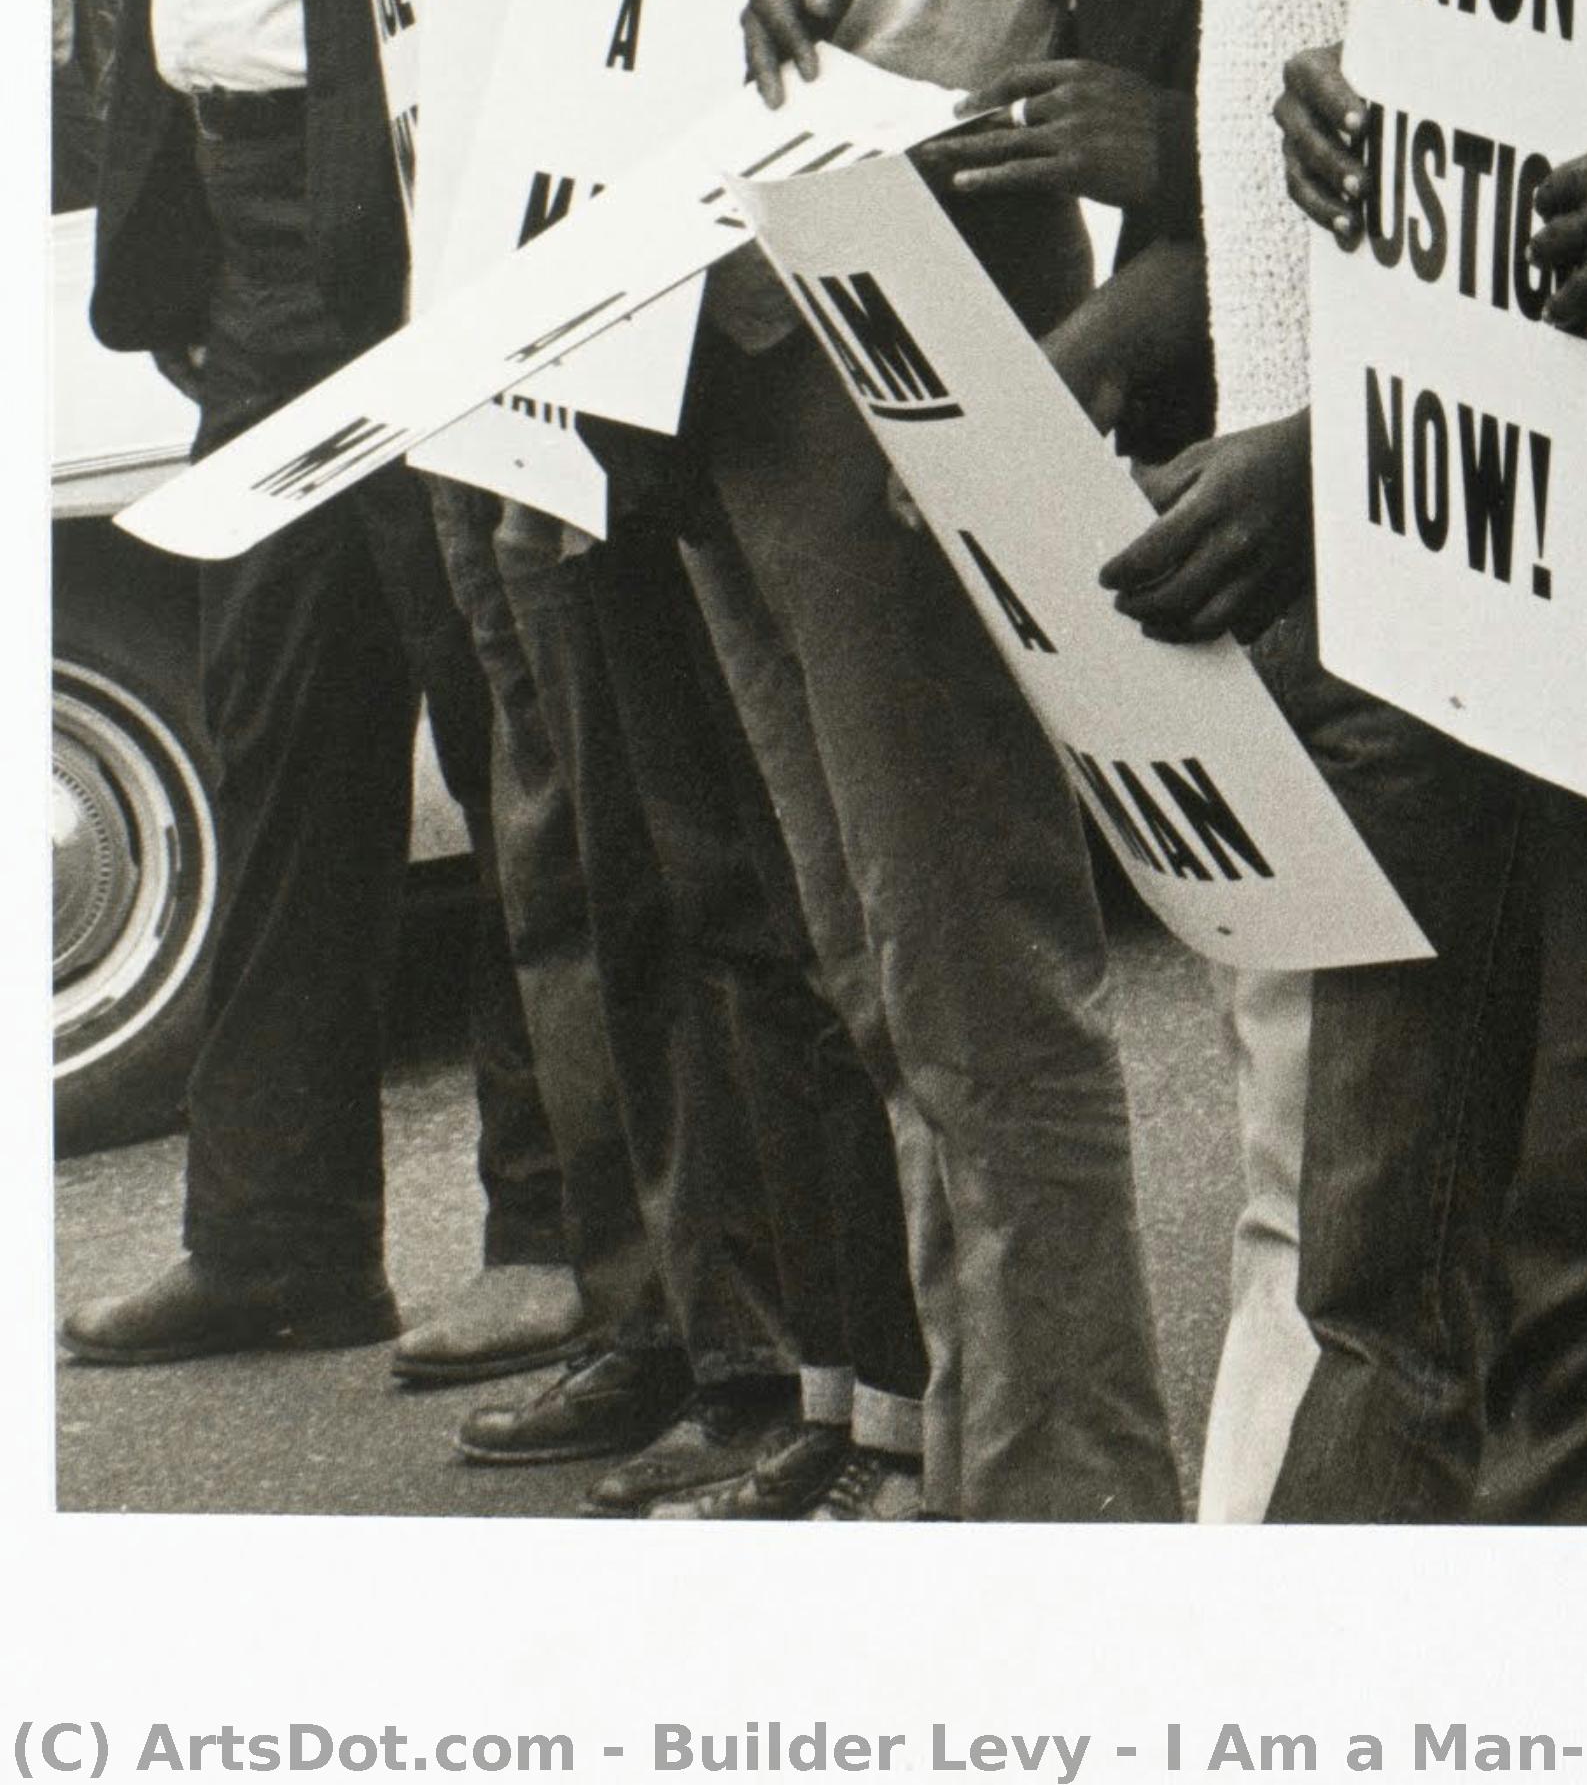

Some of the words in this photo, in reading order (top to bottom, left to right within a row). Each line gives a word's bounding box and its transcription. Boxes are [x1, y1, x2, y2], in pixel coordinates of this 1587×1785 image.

[1352, 101, 1560, 322] USTIC
[1366, 368, 1551, 600] NOW!
[958, 530, 1059, 654] A
[1066, 744, 1275, 882] MAN
